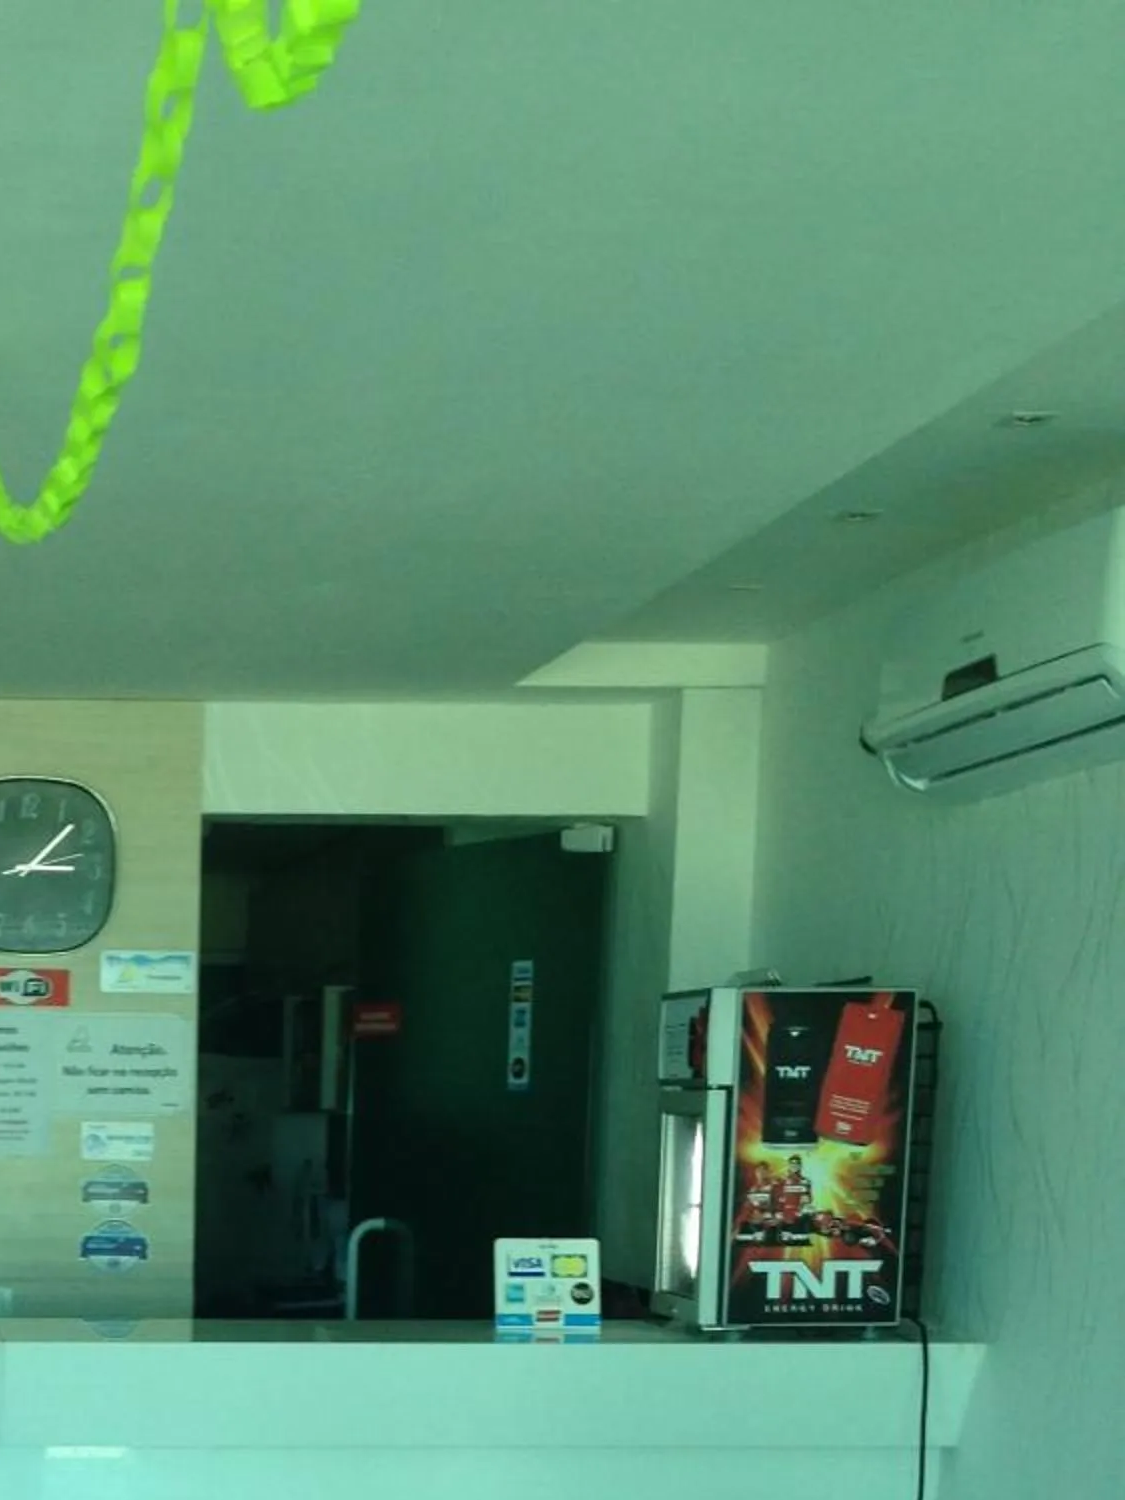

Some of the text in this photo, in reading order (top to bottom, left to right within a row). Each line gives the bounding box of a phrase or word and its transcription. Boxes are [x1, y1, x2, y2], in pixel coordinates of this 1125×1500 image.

[843, 1044, 884, 1064] TNT
[775, 1065, 812, 1079] TNT
[747, 1260, 884, 1300] TNT
[764, 1303, 864, 1313] ENERGY DRINK
